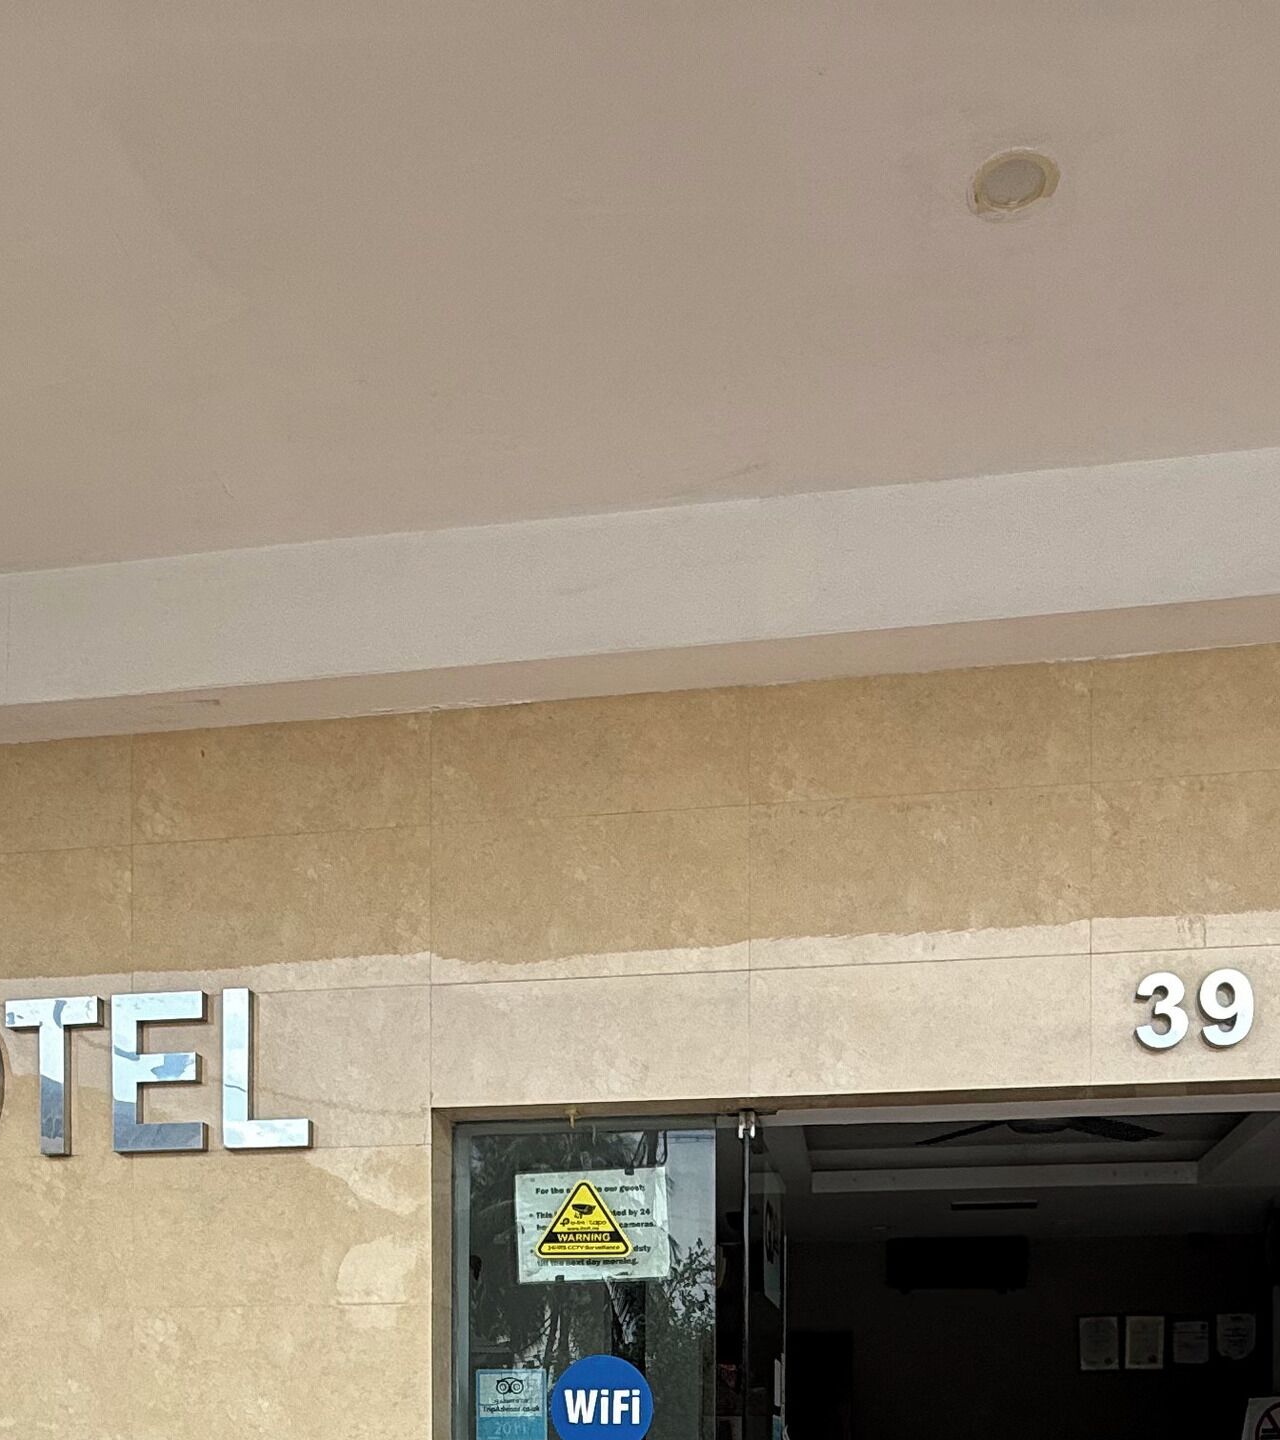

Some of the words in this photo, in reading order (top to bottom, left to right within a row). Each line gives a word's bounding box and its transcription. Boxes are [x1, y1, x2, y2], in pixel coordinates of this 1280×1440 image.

[1135, 968, 1254, 1050] 39
[535, 1187, 549, 1195] For
[628, 1208, 639, 1218] by
[557, 1232, 611, 1242] WARNING
[586, 1258, 601, 1266] day
[564, 1389, 641, 1425] WiFi
